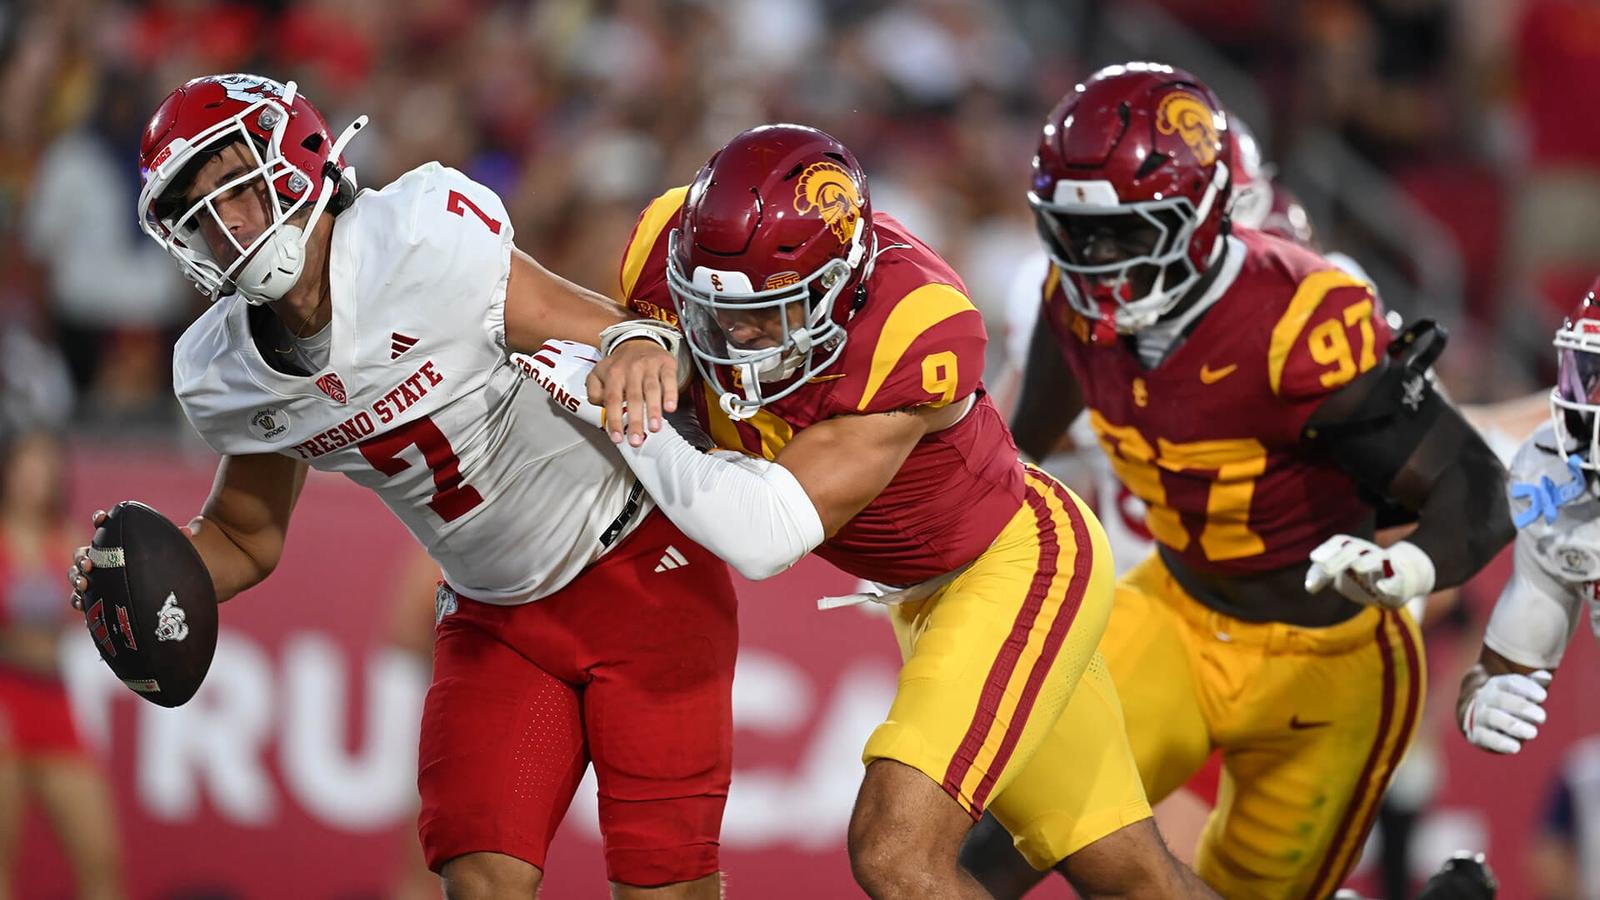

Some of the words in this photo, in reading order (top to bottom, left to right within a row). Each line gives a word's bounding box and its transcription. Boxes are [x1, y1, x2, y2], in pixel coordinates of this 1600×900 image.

[447, 189, 502, 235] 7
[921, 350, 958, 408] 9
[1308, 299, 1377, 388] 97
[290, 411, 376, 460] FRESNO
[371, 360, 444, 424] STATE
[515, 357, 581, 413] TROJANS
[357, 415, 485, 523] 7
